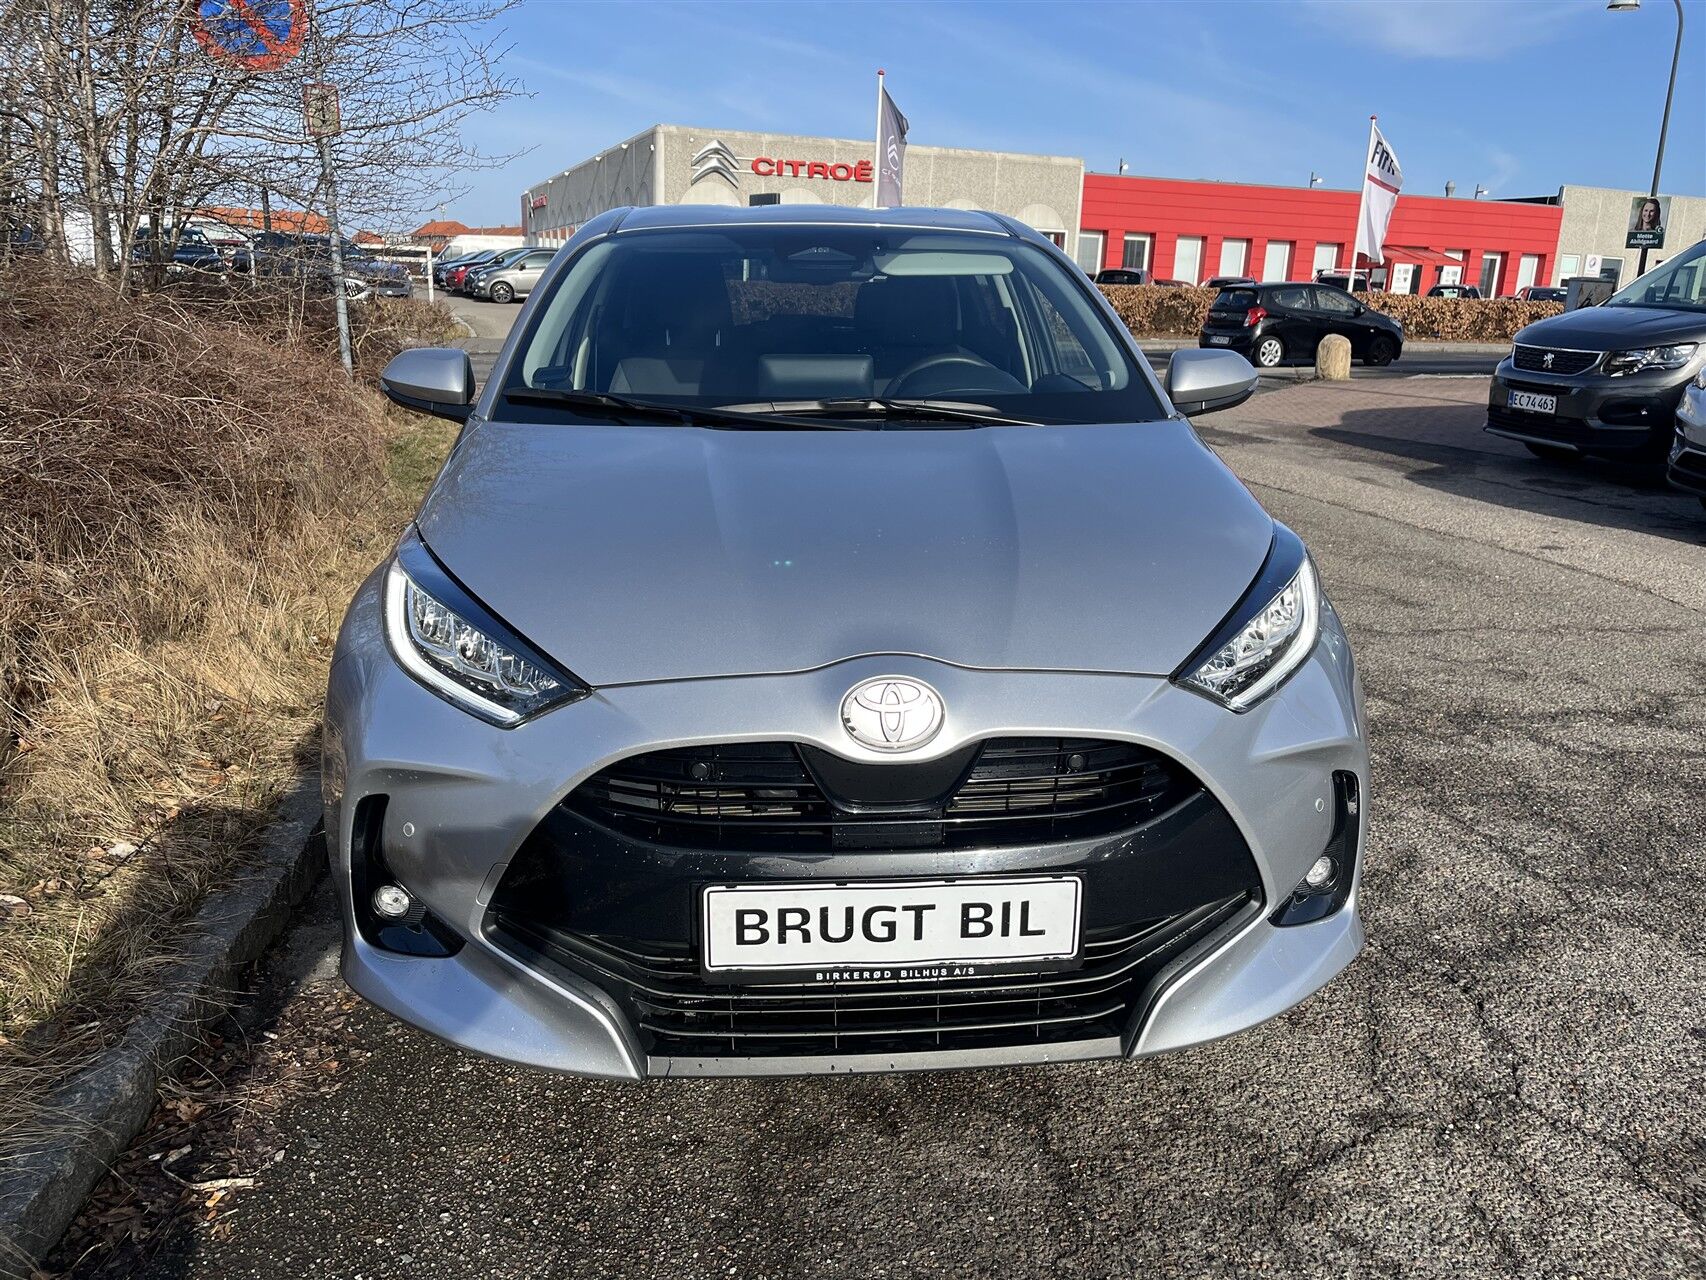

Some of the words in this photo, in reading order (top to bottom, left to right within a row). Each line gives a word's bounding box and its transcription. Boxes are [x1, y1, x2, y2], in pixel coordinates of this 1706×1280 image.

[751, 157, 874, 183] CITROË
[735, 904, 936, 946] BRUGT
[960, 900, 1046, 938] BIL
[815, 970, 892, 981] BIRKERØD
[900, 967, 948, 978] BILHUS
[954, 966, 976, 976] A/S
